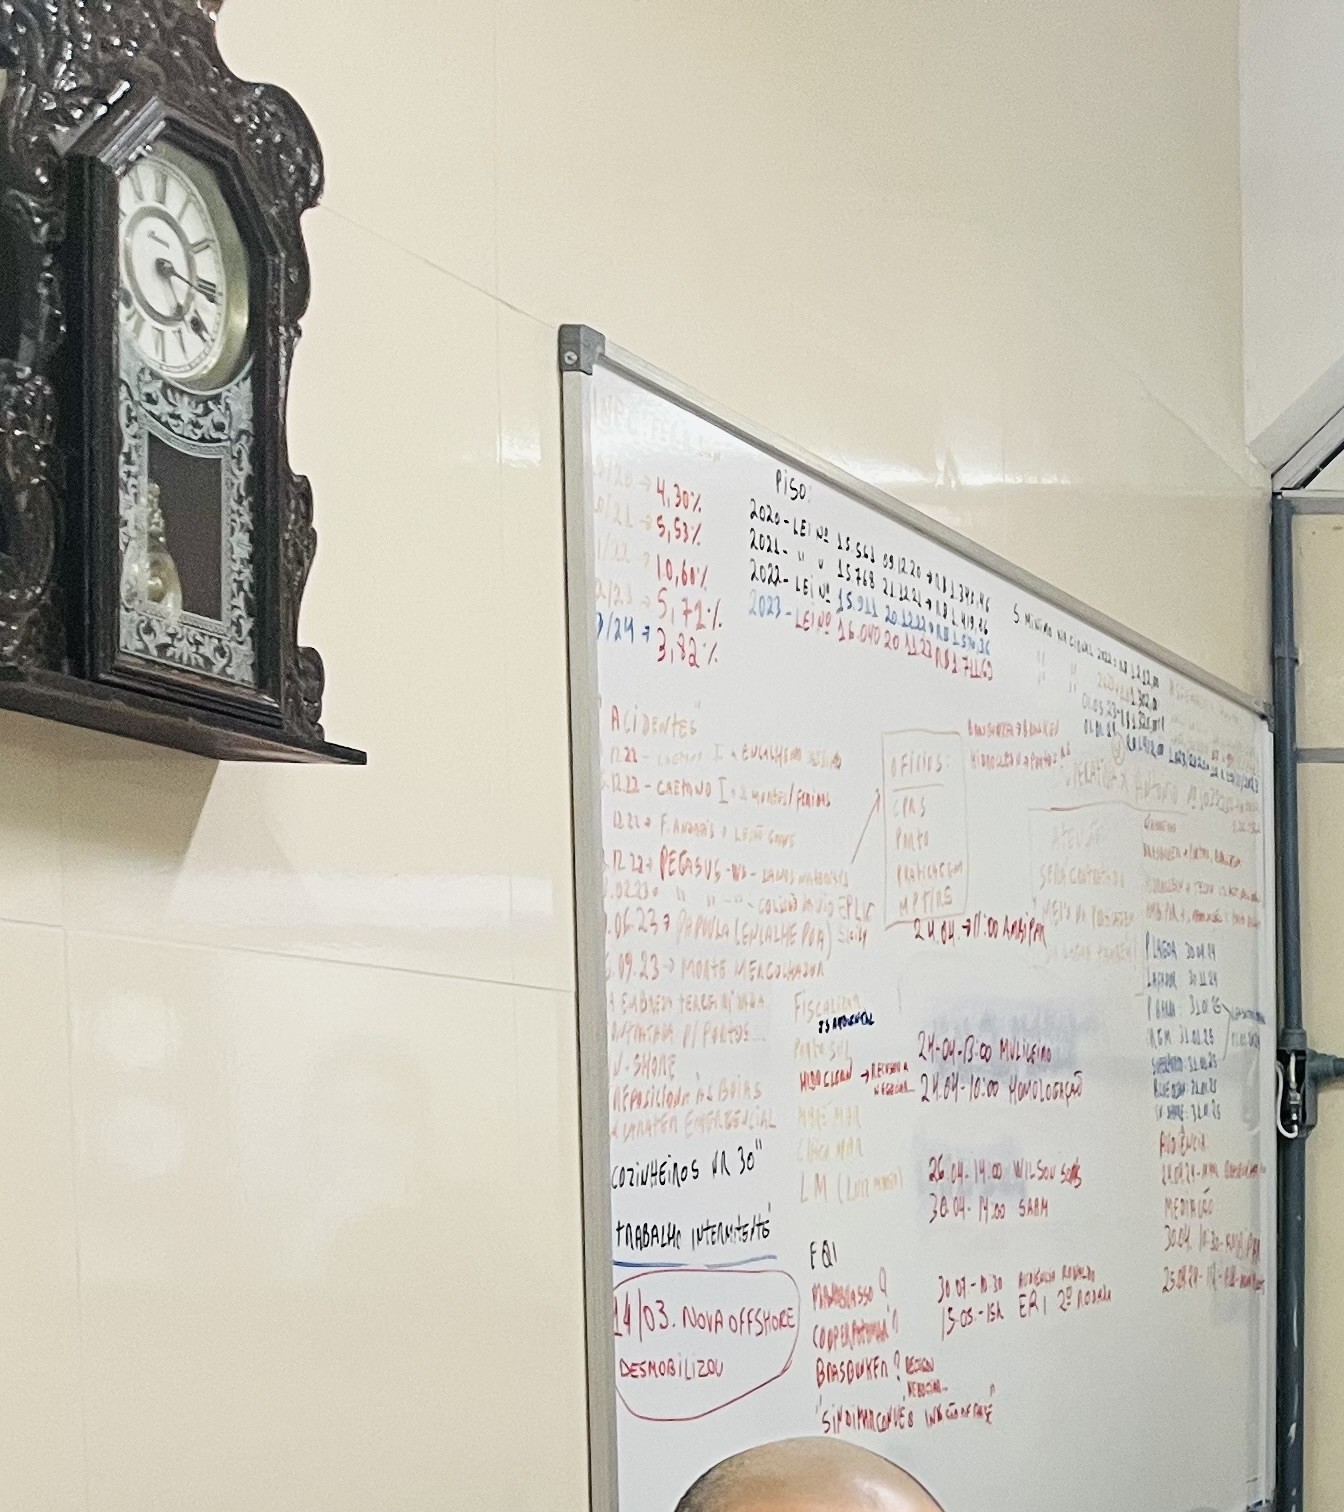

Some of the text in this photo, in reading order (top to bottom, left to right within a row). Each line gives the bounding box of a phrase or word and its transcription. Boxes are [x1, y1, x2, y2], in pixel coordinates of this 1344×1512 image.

[611, 1155, 699, 1189] COZINHEIROS
[616, 1220, 681, 1250] TRABALHO
[682, 1305, 723, 1333] NOVA
[728, 1307, 796, 1338] OFFSHORE
[619, 1352, 724, 1380] DESMOBILIZOU
